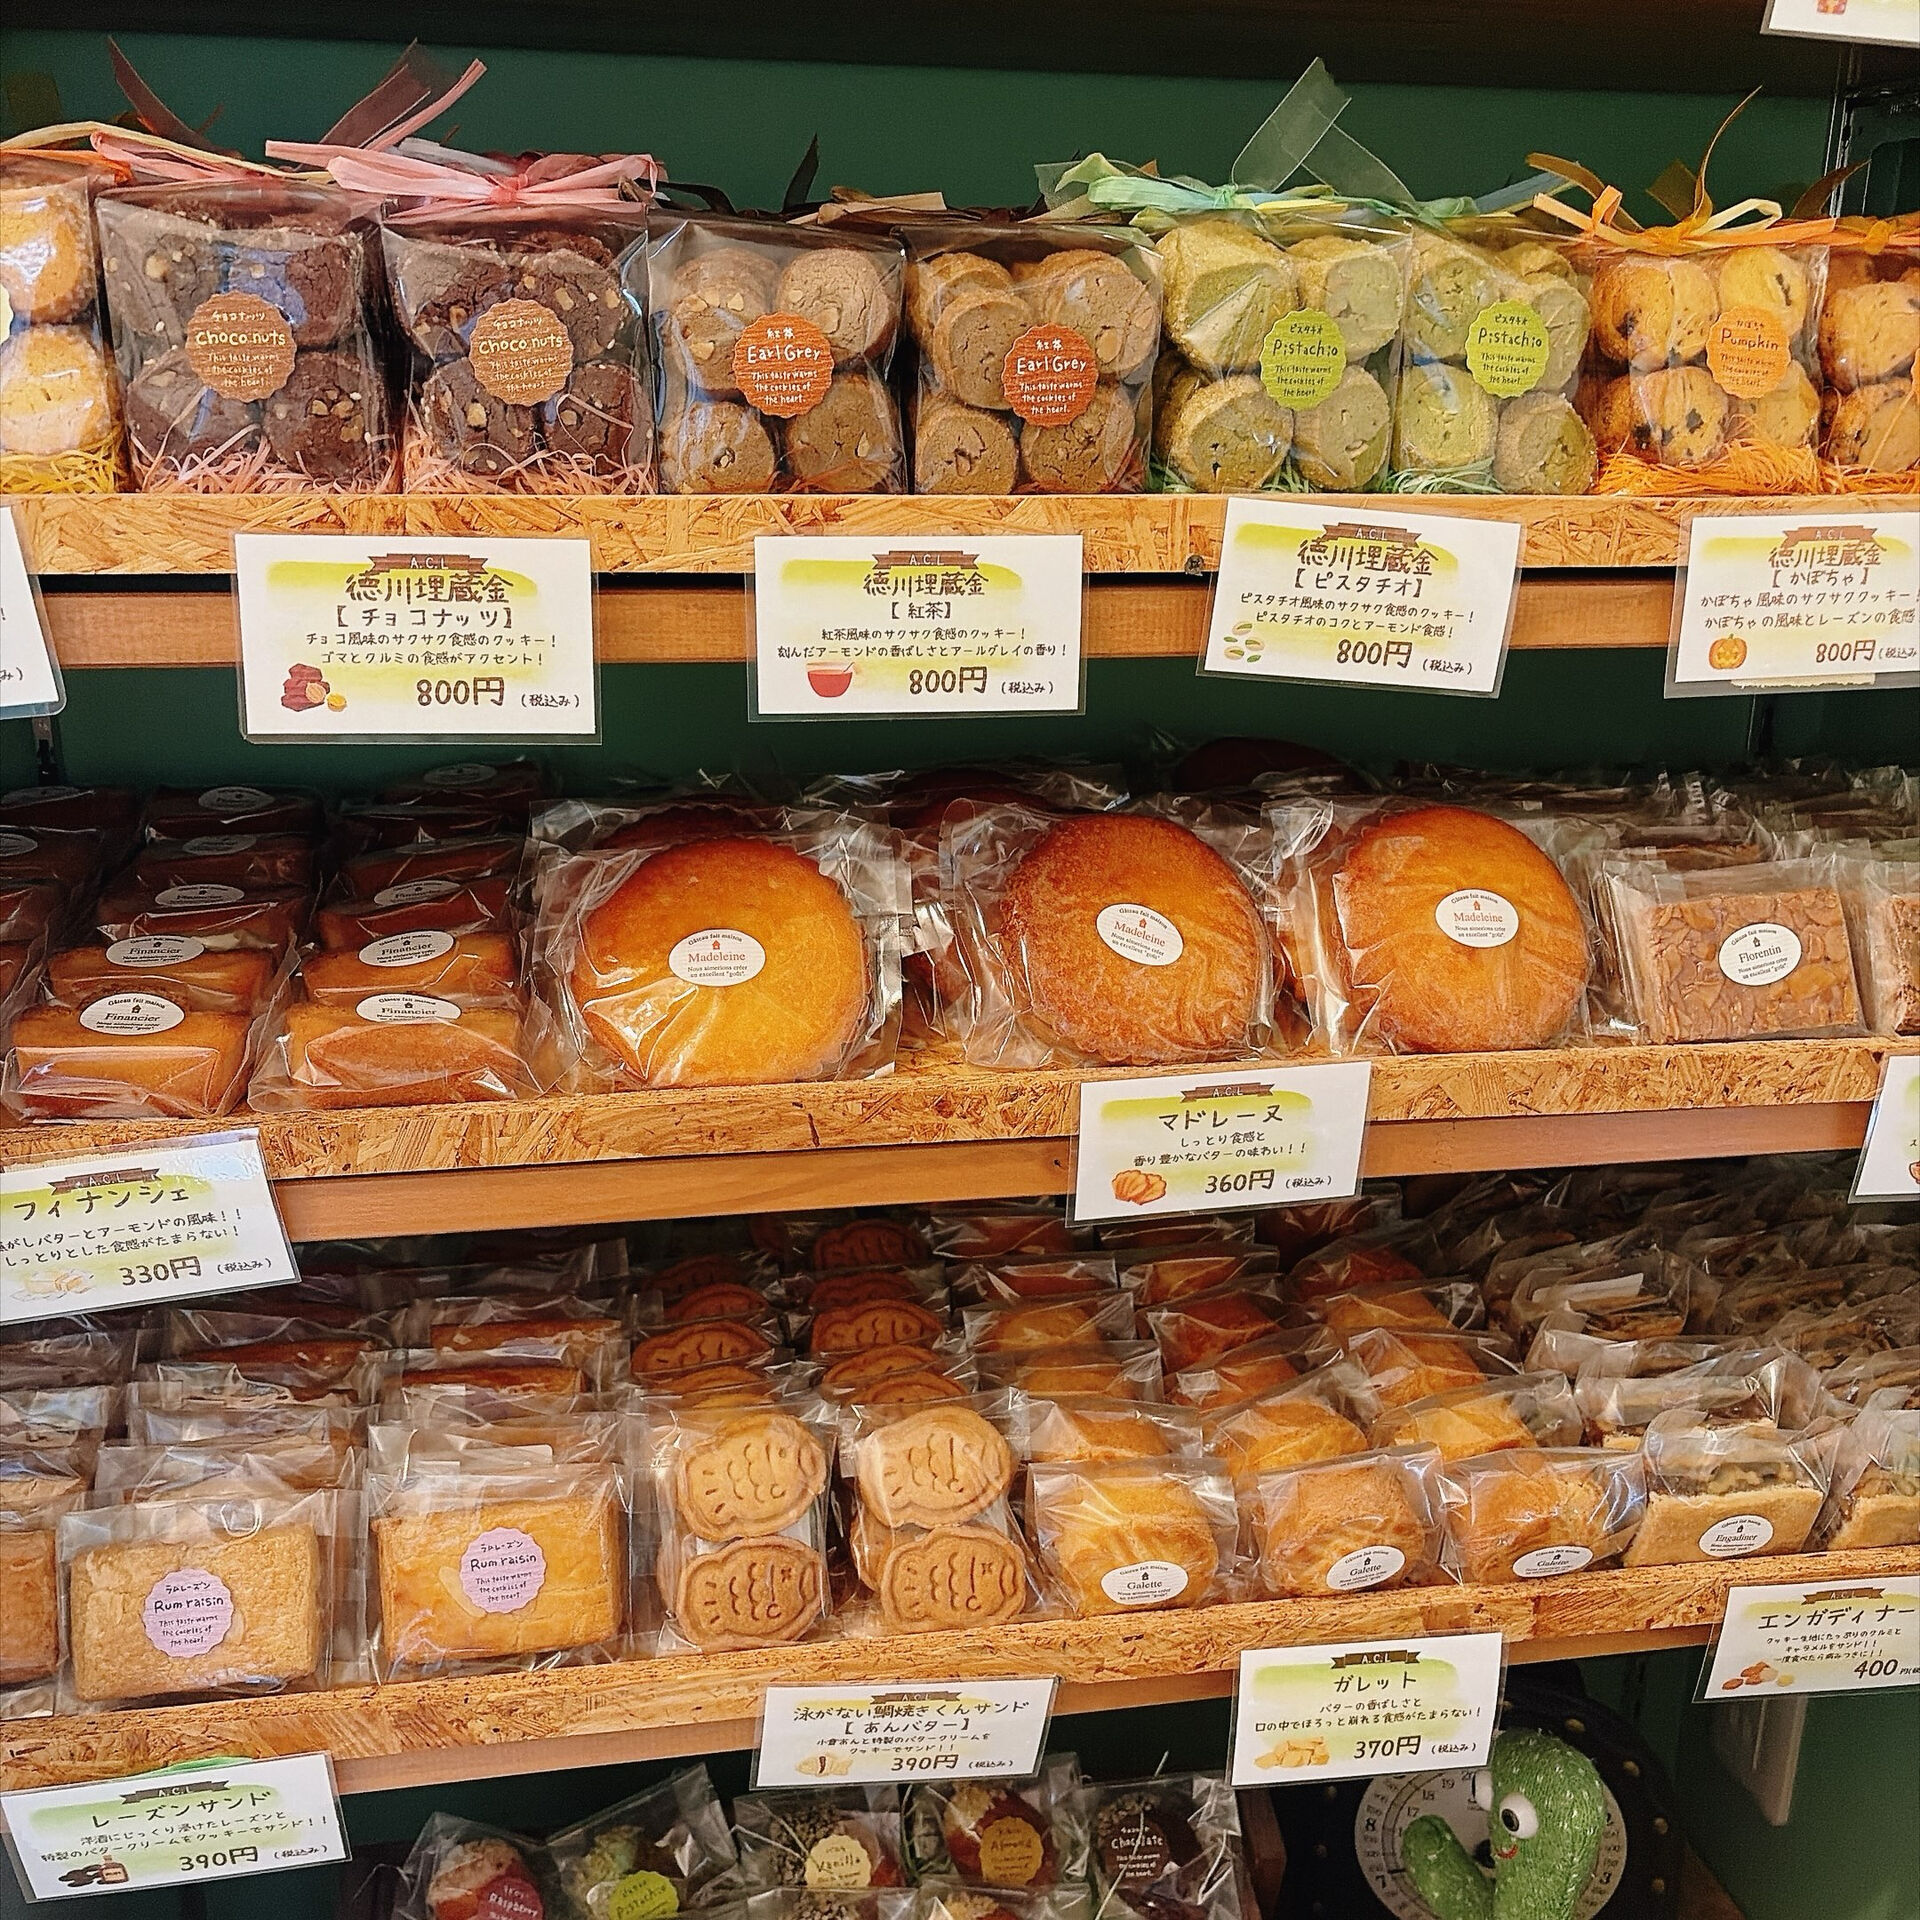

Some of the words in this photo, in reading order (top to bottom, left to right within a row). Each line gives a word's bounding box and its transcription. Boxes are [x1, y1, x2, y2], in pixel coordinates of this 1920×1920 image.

[1478, 327, 1542, 347] Pistachio
[1721, 328, 1779, 350] Pumpkin
[1273, 339, 1338, 357] Pistachio
[1297, 538, 1438, 576] 徳川埋蔵金
[1768, 542, 1887, 569] 徳川埋蔵金
[345, 572, 514, 605] 徳川埋蔵金
[863, 571, 989, 597] 徳川埋蔵金
[306, 632, 557, 648] チョコ風味のサクサク食感のクッキー！
[822, 627, 1026, 641] 紅茶風味のサクサク食感のクッキー！
[321, 651, 544, 666] ゴマとクルミの食感がアクセント！
[1336, 638, 1413, 669] 800円
[1816, 640, 1876, 663] 800円
[909, 666, 988, 695] 800円
[416, 676, 504, 707] 800円
[1454, 912, 1503, 922] Madeleine
[1114, 921, 1166, 947] Madeleine
[129, 947, 182, 955] Financier
[381, 943, 432, 955] Financier
[688, 952, 746, 963] Madeleine
[1739, 945, 1781, 963] Florentin
[104, 1012, 161, 1022] Financier
[1159, 1104, 1283, 1131] マドレーヌ
[1181, 1131, 1266, 1148] しっとり食感と
[1205, 1169, 1275, 1194] 360円
[14, 1187, 189, 1221] フィナンシェ
[120, 1256, 202, 1287] 330円
[470, 1559, 497, 1572] Rum
[501, 1555, 536, 1566] raisin
[1350, 1564, 1381, 1576] Galette
[166, 1581, 211, 1594] ラムレーズン
[1127, 1581, 1162, 1590] Galette
[154, 1600, 183, 1614] Rum
[186, 1597, 223, 1608] raisin
[1758, 1604, 1915, 1630] エンガディナー
[1334, 1671, 1417, 1693] ガレット
[794, 1701, 1029, 1722] 泳がない鯛焼きくんサンド
[1320, 1698, 1422, 1713] バターの香ばしさと
[1354, 1735, 1422, 1759] 370円
[891, 1754, 960, 1772] 390円
[92, 1790, 272, 1828] レーズンサンド
[179, 1846, 258, 1872] 390円
